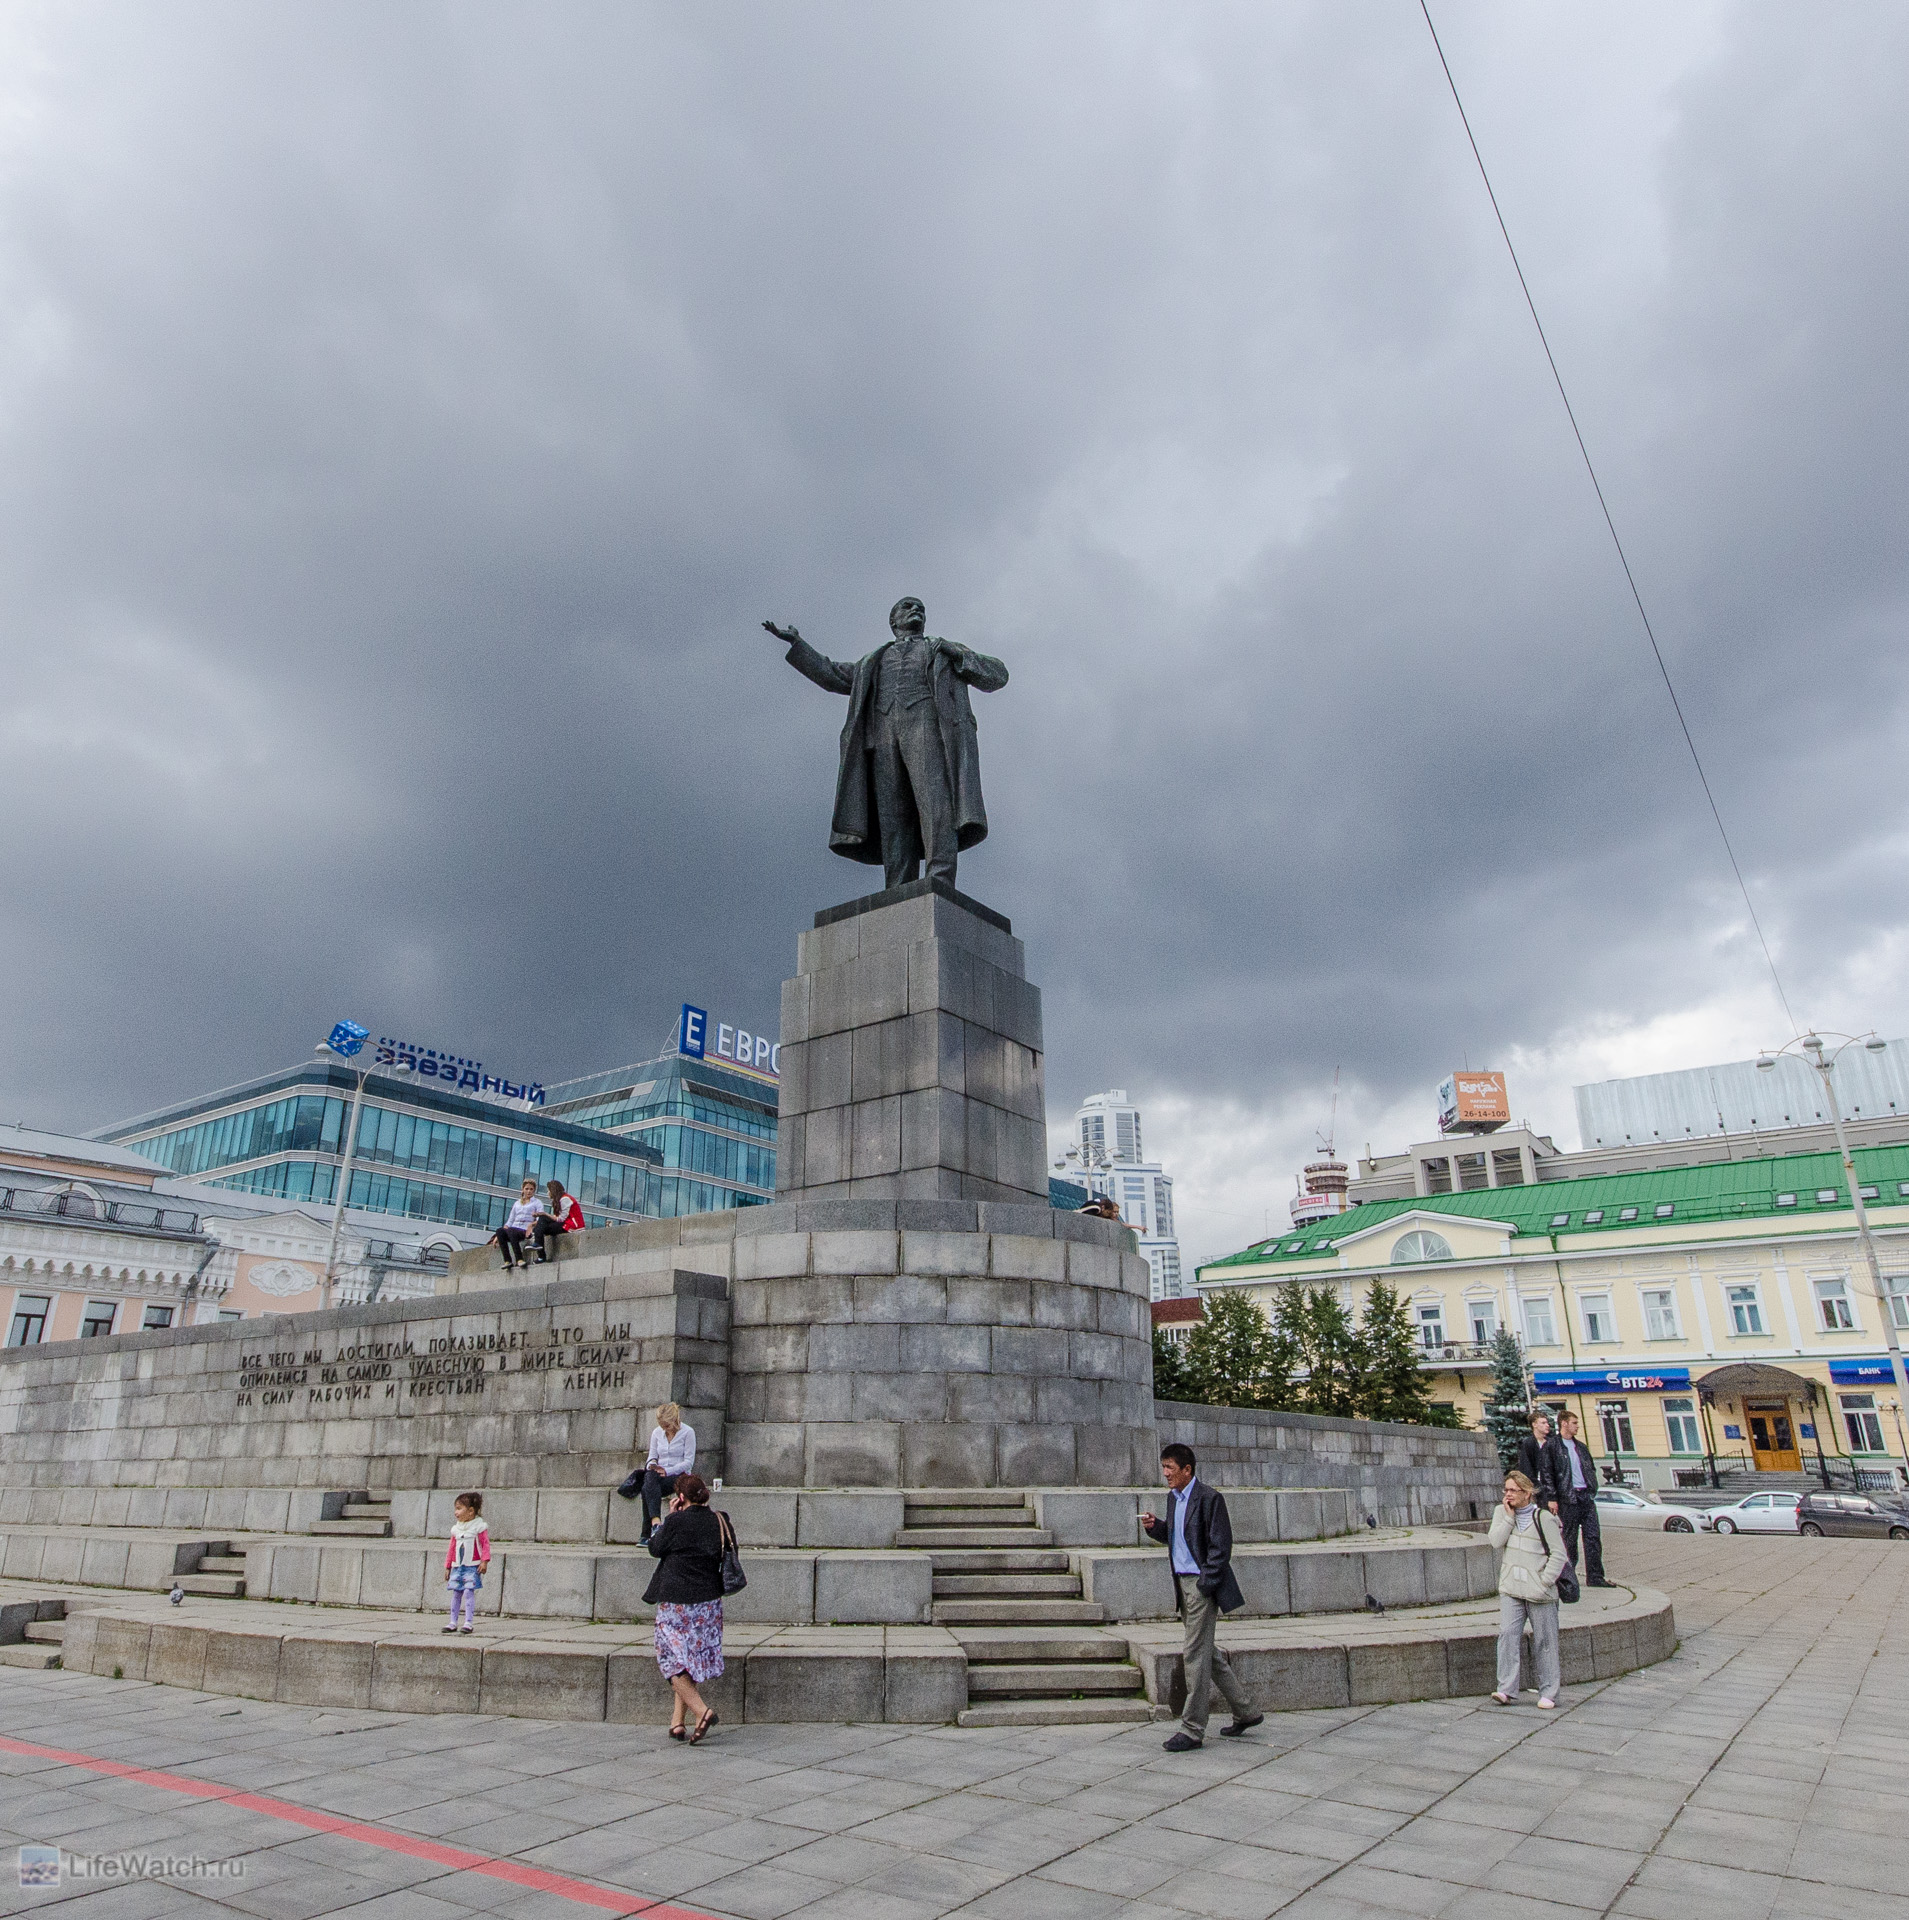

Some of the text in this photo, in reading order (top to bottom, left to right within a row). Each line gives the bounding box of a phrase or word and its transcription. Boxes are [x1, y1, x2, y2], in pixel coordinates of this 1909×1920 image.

[379, 1037, 483, 1070] СУПЕРМАРКЕТ
[1463, 1110, 1507, 1118] 26-14-100
[242, 1354, 262, 1369] ВСЕ
[268, 1352, 295, 1367] ЧЕГО
[303, 1349, 323, 1363] МЫ
[551, 1327, 584, 1344] ЧТО
[604, 1323, 631, 1341] МЫ
[239, 1369, 308, 1387] ОПИРАЕМСЯ
[321, 1367, 338, 1383] НА
[347, 1364, 392, 1380] САМУЮ
[409, 1357, 485, 1376] ЧУДЕСНУЮ
[500, 1355, 507, 1370] В
[523, 1351, 564, 1369] МИРЕ
[565, 1371, 625, 1390] ЛЕНИН
[1858, 1367, 1881, 1375] БАНК
[237, 1378, 485, 1407] НА СИЛУ РАБОЧИХ И КРЕСТЬЯН
[1621, 1376, 1664, 1389] ВТБ24
